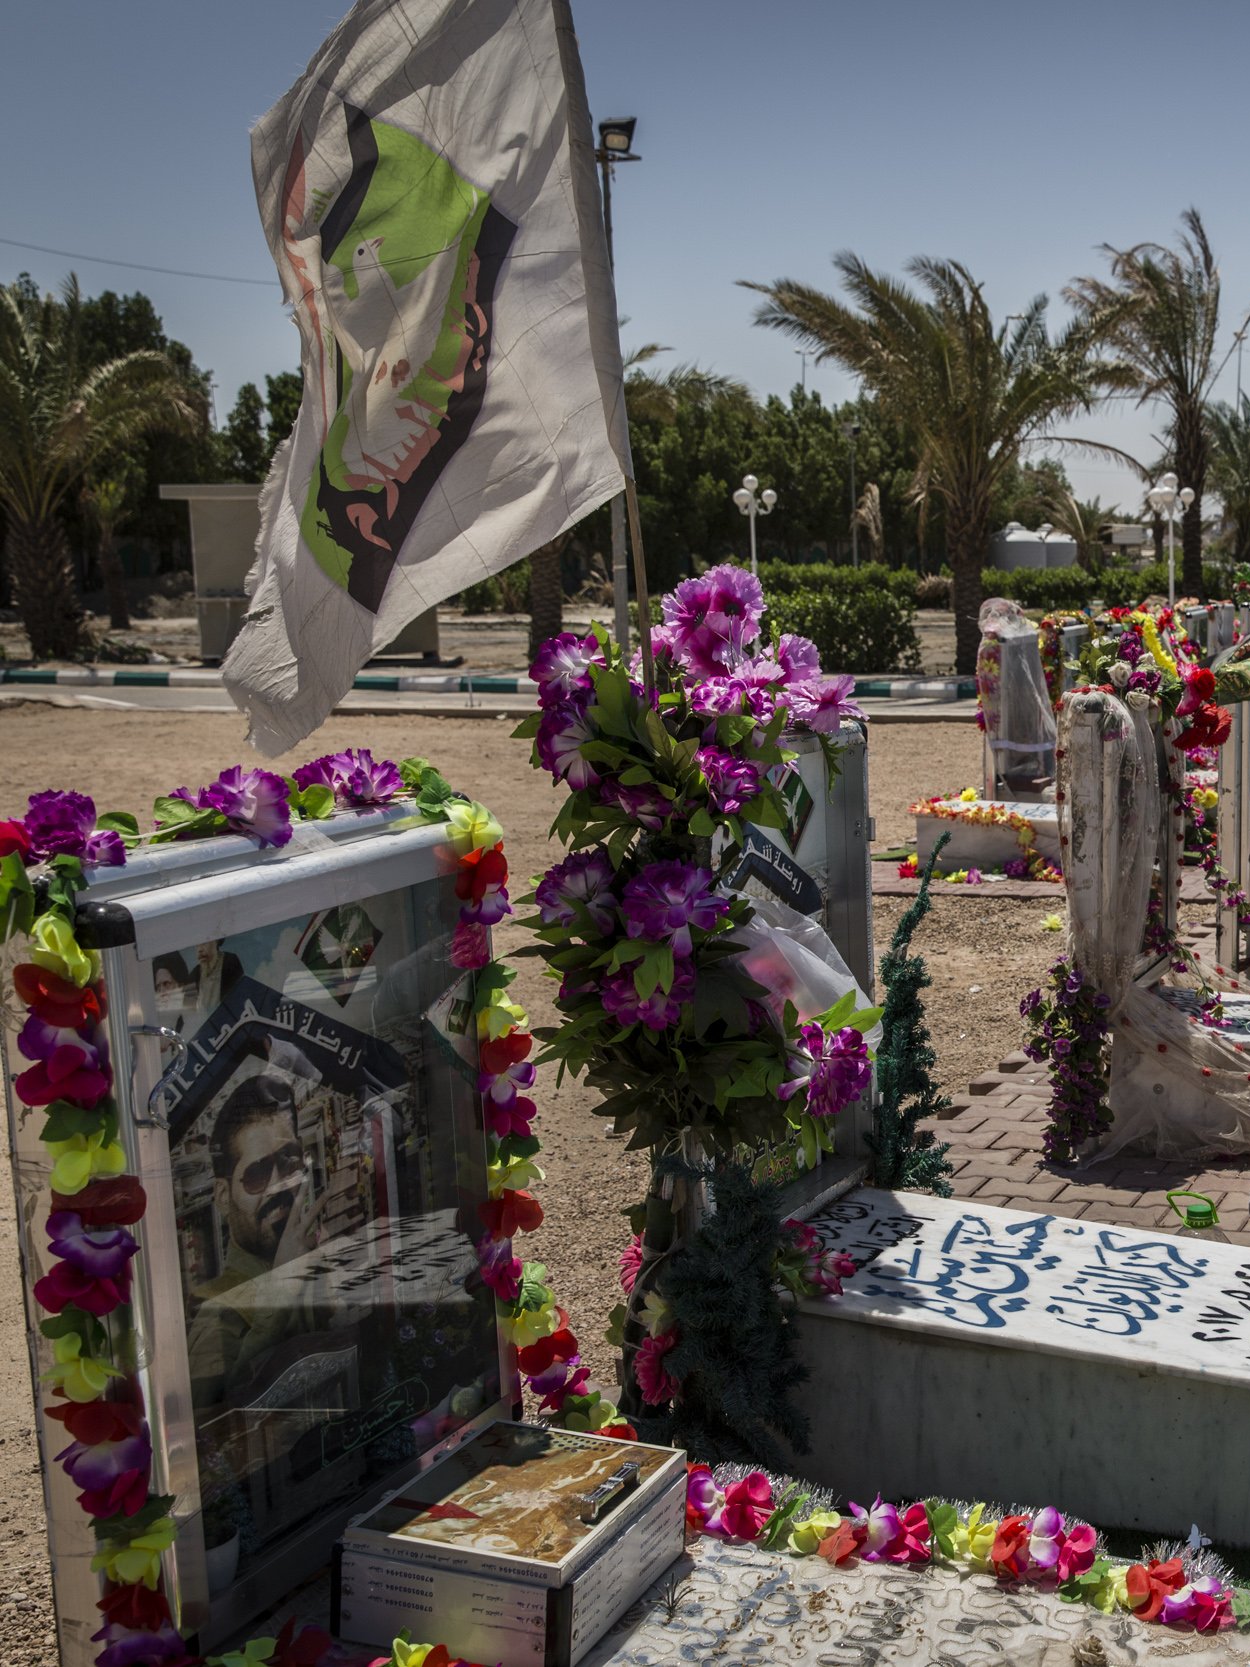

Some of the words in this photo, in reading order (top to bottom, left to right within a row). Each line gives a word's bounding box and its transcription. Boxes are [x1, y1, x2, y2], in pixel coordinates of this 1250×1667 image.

[773, 851, 803, 894] روضة
[193, 997, 295, 1078] شهداء
[293, 1005, 361, 1071] روضة
